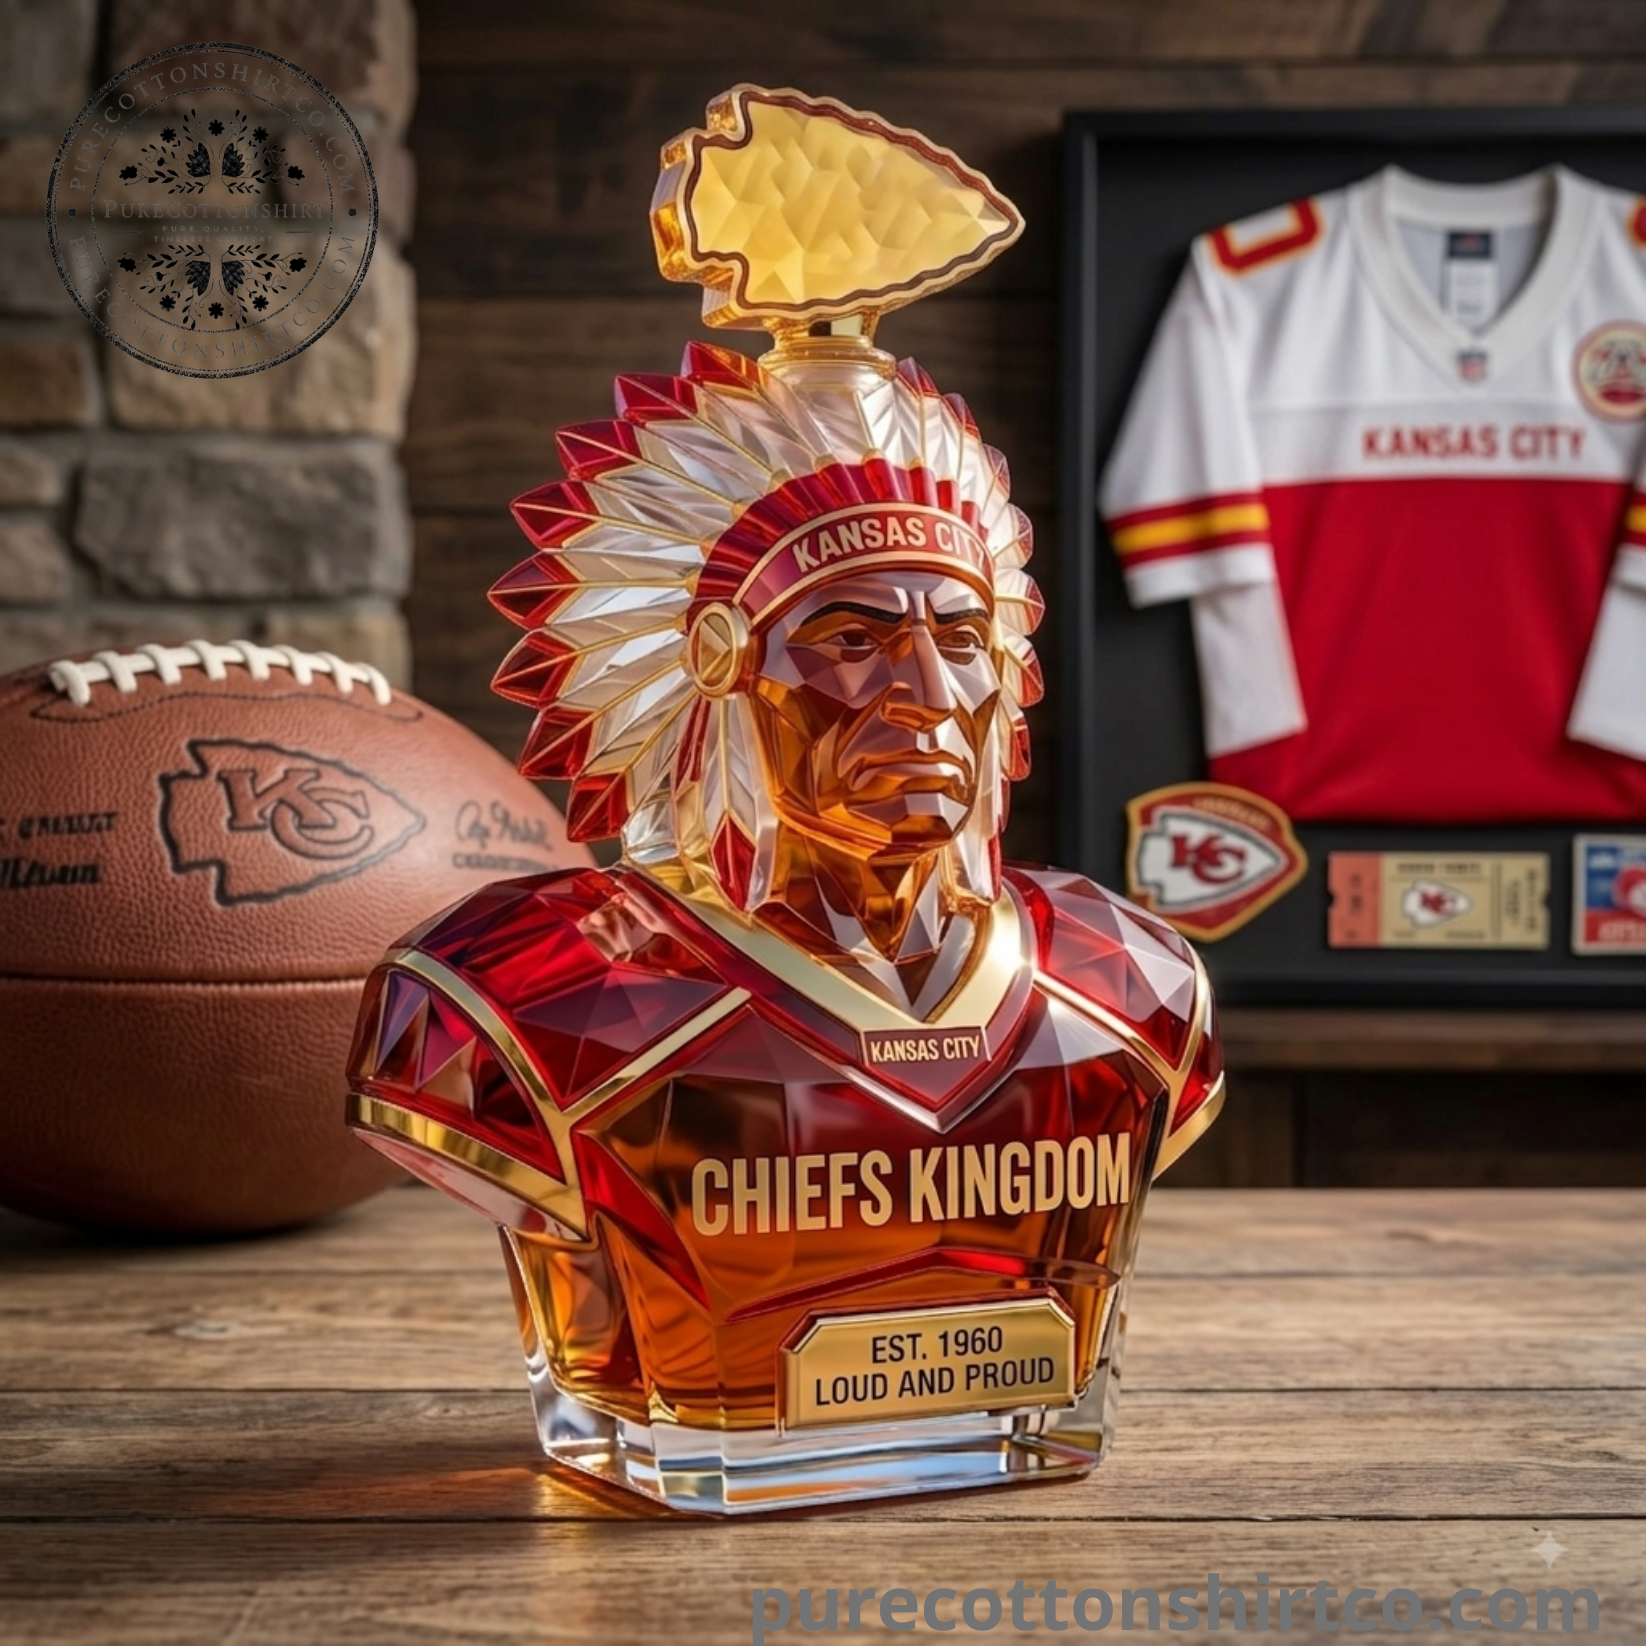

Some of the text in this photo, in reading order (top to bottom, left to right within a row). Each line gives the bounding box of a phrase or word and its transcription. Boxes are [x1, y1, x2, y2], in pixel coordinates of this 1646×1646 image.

[1362, 424, 1585, 460] KANSAS CITY
[792, 517, 984, 573] KANSAS CITY
[216, 768, 374, 859] KC
[1170, 833, 1247, 886] KC
[870, 1035, 979, 1062] KANSAS CITY
[691, 1132, 1131, 1237] CHIEFS KINGDOM
[871, 1325, 1003, 1364] EST. 1960
[815, 1357, 1055, 1406] LOUD AND PROUD
